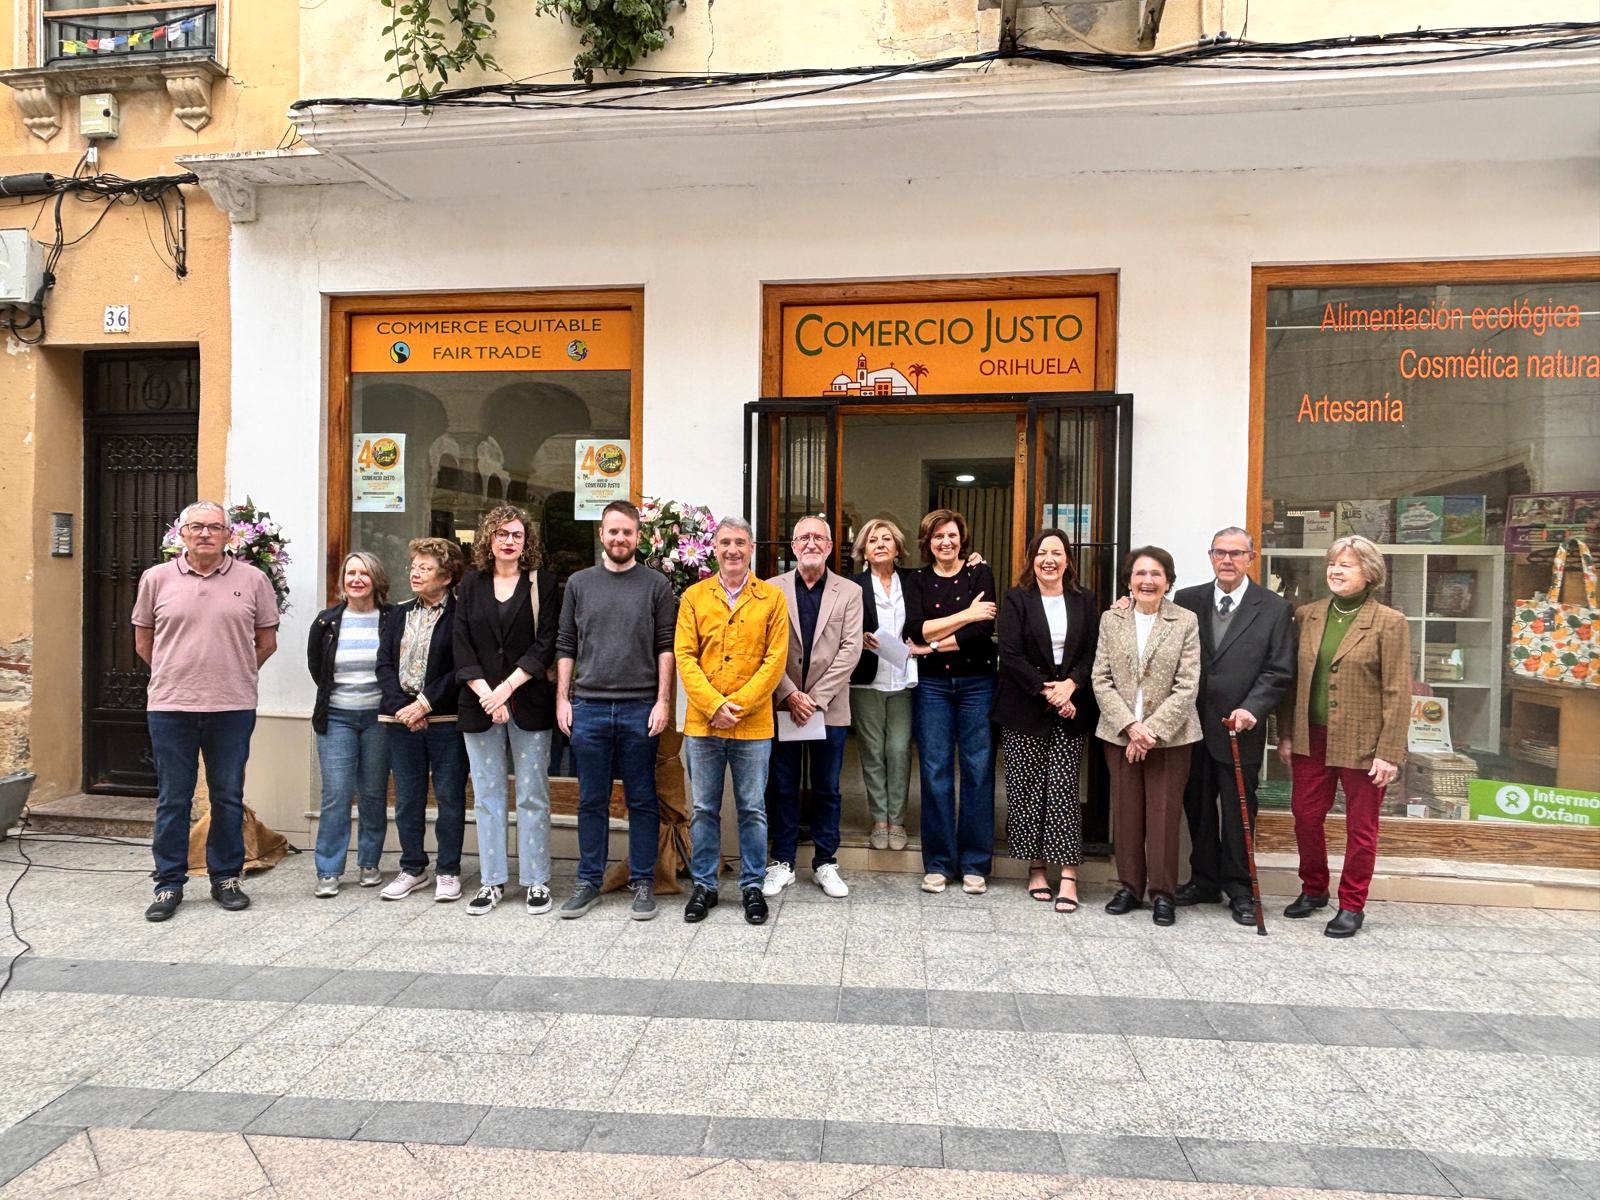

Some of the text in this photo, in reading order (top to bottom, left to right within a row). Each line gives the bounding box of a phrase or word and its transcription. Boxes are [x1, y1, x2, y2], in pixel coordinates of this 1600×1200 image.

[106, 311, 126, 326] 36
[377, 318, 602, 335] COMMERCE EQUITABLE
[1321, 298, 1581, 336] Alimentación ecológica
[795, 308, 1083, 356] COMERCIO JUSTO
[433, 346, 541, 359] FAIR TRADE
[979, 358, 1081, 376] ORIHUELA
[1400, 348, 1518, 379] Cosmética
[1297, 392, 1403, 423] Artesanía
[1534, 789, 1600, 808] Intermó
[1533, 805, 1589, 824] Oxfam
